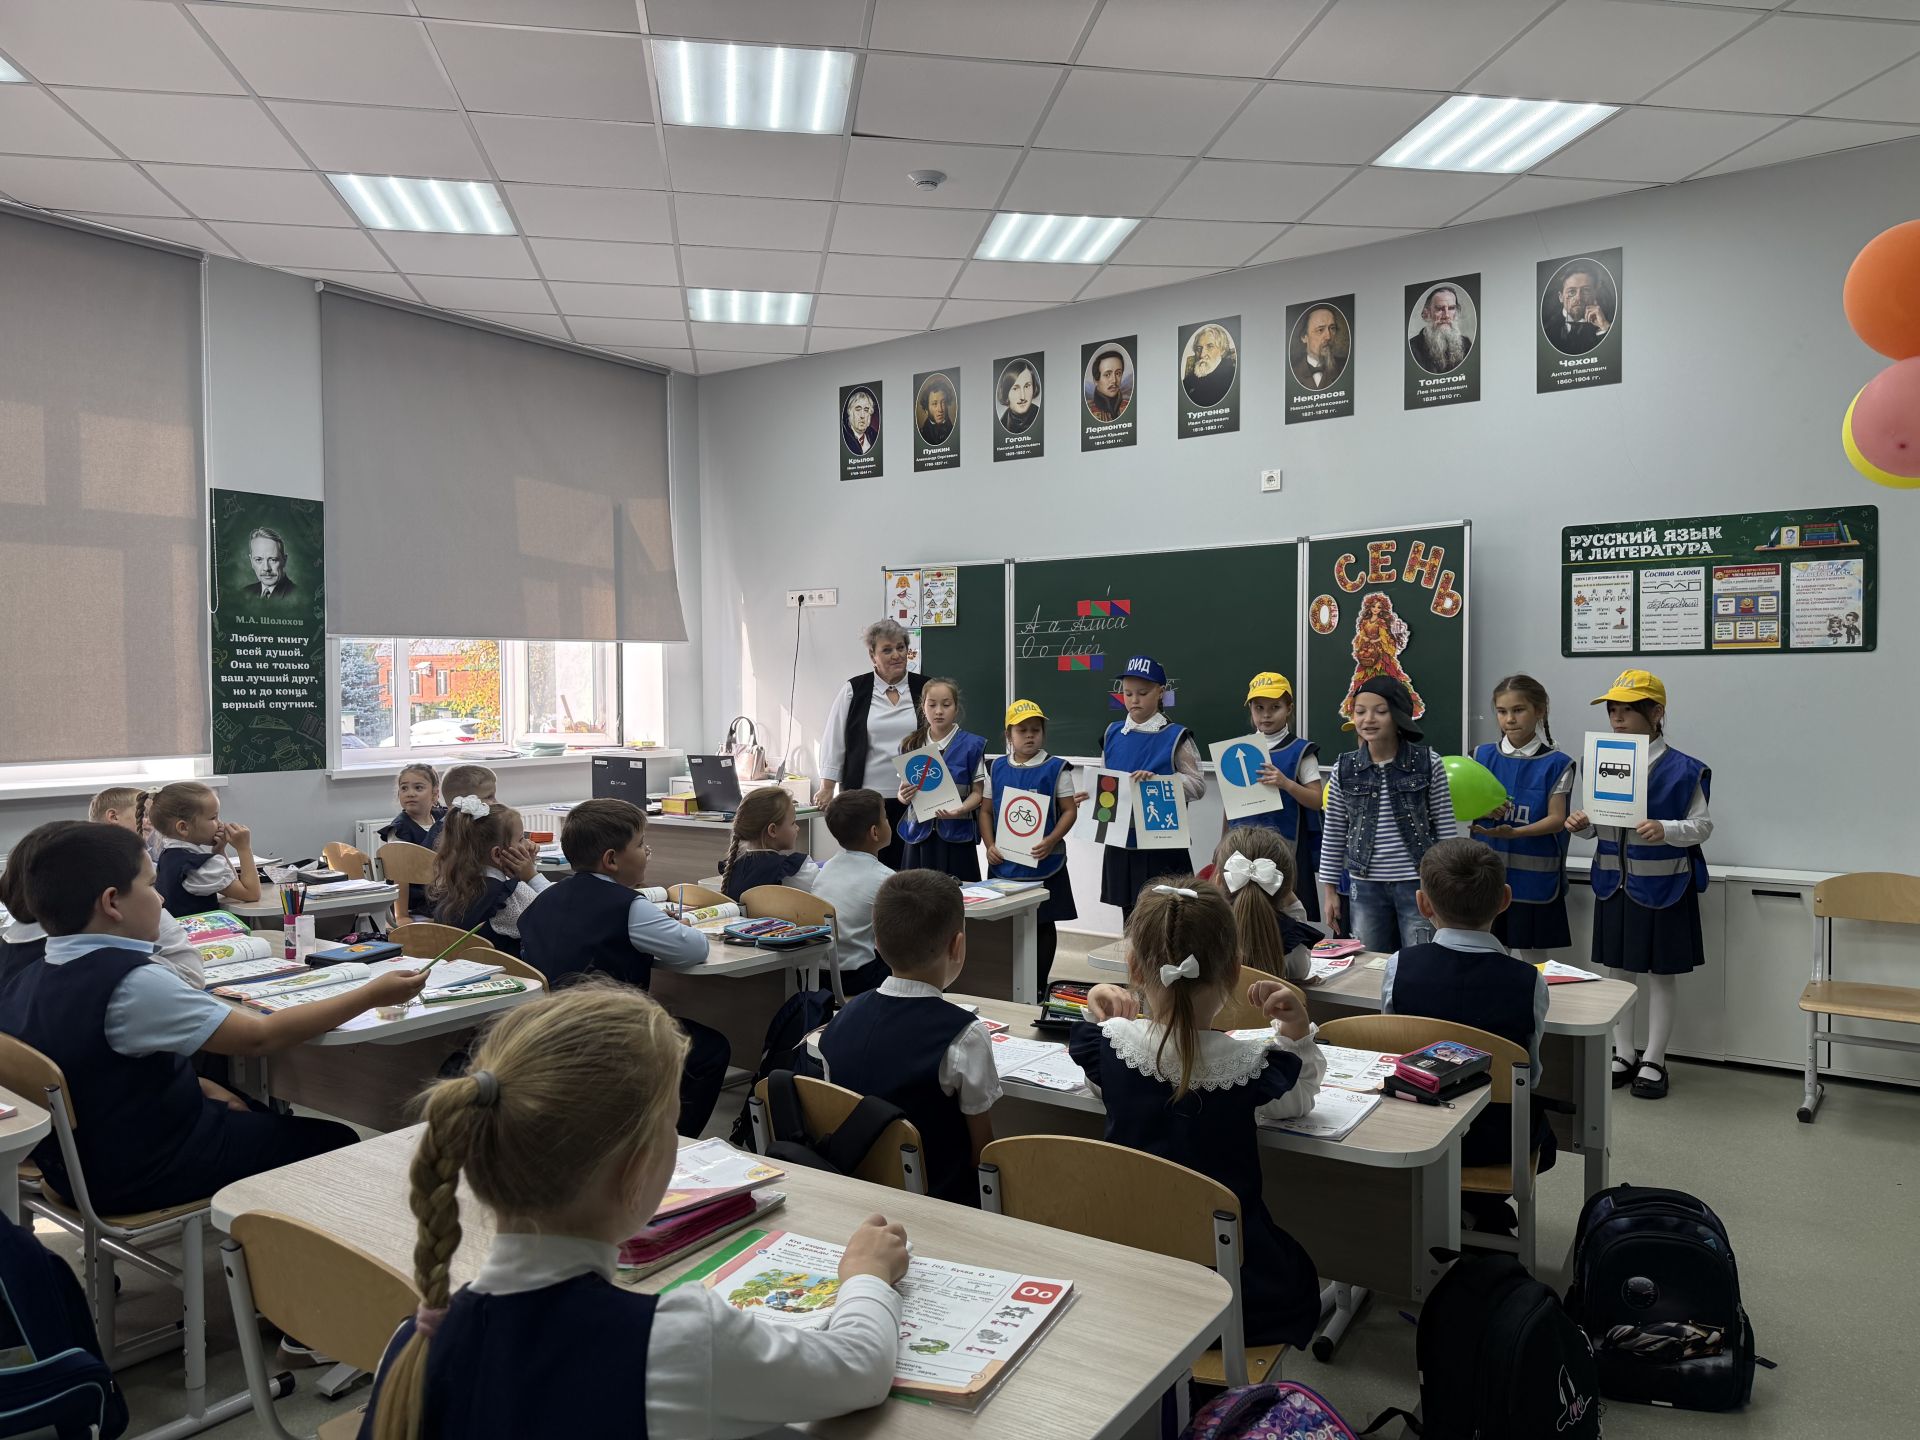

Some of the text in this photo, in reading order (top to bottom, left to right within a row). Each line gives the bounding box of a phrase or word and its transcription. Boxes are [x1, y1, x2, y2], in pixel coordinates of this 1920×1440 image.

[1558, 357, 1598, 367] Чехов
[1573, 366, 1607, 374] Павлович
[1418, 373, 1466, 386] Толстой
[1556, 376, 1590, 385] 1860-1904
[1293, 390, 1345, 403] Некрасов
[1186, 407, 1231, 419] Тургенев
[1085, 422, 1133, 434] Лермонтов
[1004, 436, 1032, 444] Гоголь
[922, 447, 951, 456] Пушкин
[848, 456, 875, 465] Крылов
[1569, 526, 1722, 548] РУССКИЙ ЯЗЫК
[1570, 542, 1713, 561] И ЛИТЕРАТУРА
[235, 615, 304, 626] М.А. Шолохов
[229, 633, 309, 646] Любите книгу
[235, 647, 304, 658] всей душой.
[230, 660, 253, 669] Она
[272, 662, 310, 670] только
[1127, 658, 1151, 675] ЮИД
[245, 674, 289, 684] лучший
[291, 675, 318, 684] друг,
[259, 688, 273, 696] до
[275, 688, 308, 697] конца
[222, 700, 318, 711] верный спутник.
[1020, 1286, 1053, 1299] Оо
